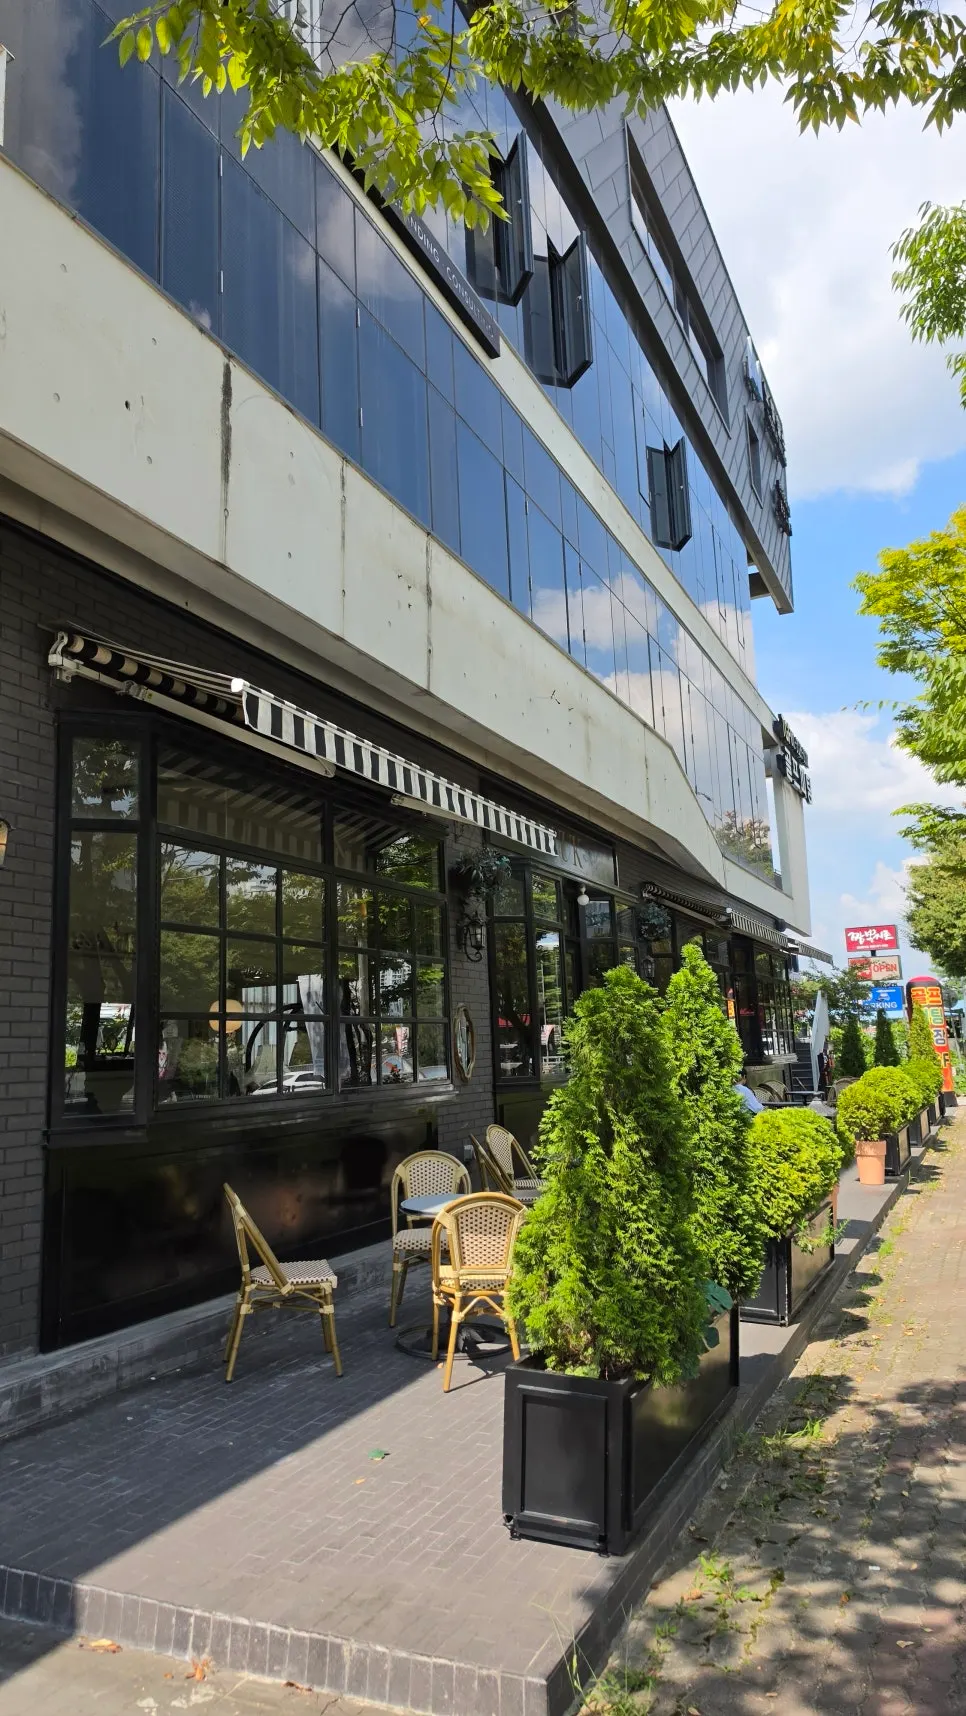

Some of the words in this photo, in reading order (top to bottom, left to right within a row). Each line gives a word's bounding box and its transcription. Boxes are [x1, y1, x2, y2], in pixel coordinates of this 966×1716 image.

[404, 208, 440, 263] NDING
[873, 964, 897, 973] OPEN
[911, 986, 942, 1006] 골프
[865, 1001, 898, 1009] RKING
